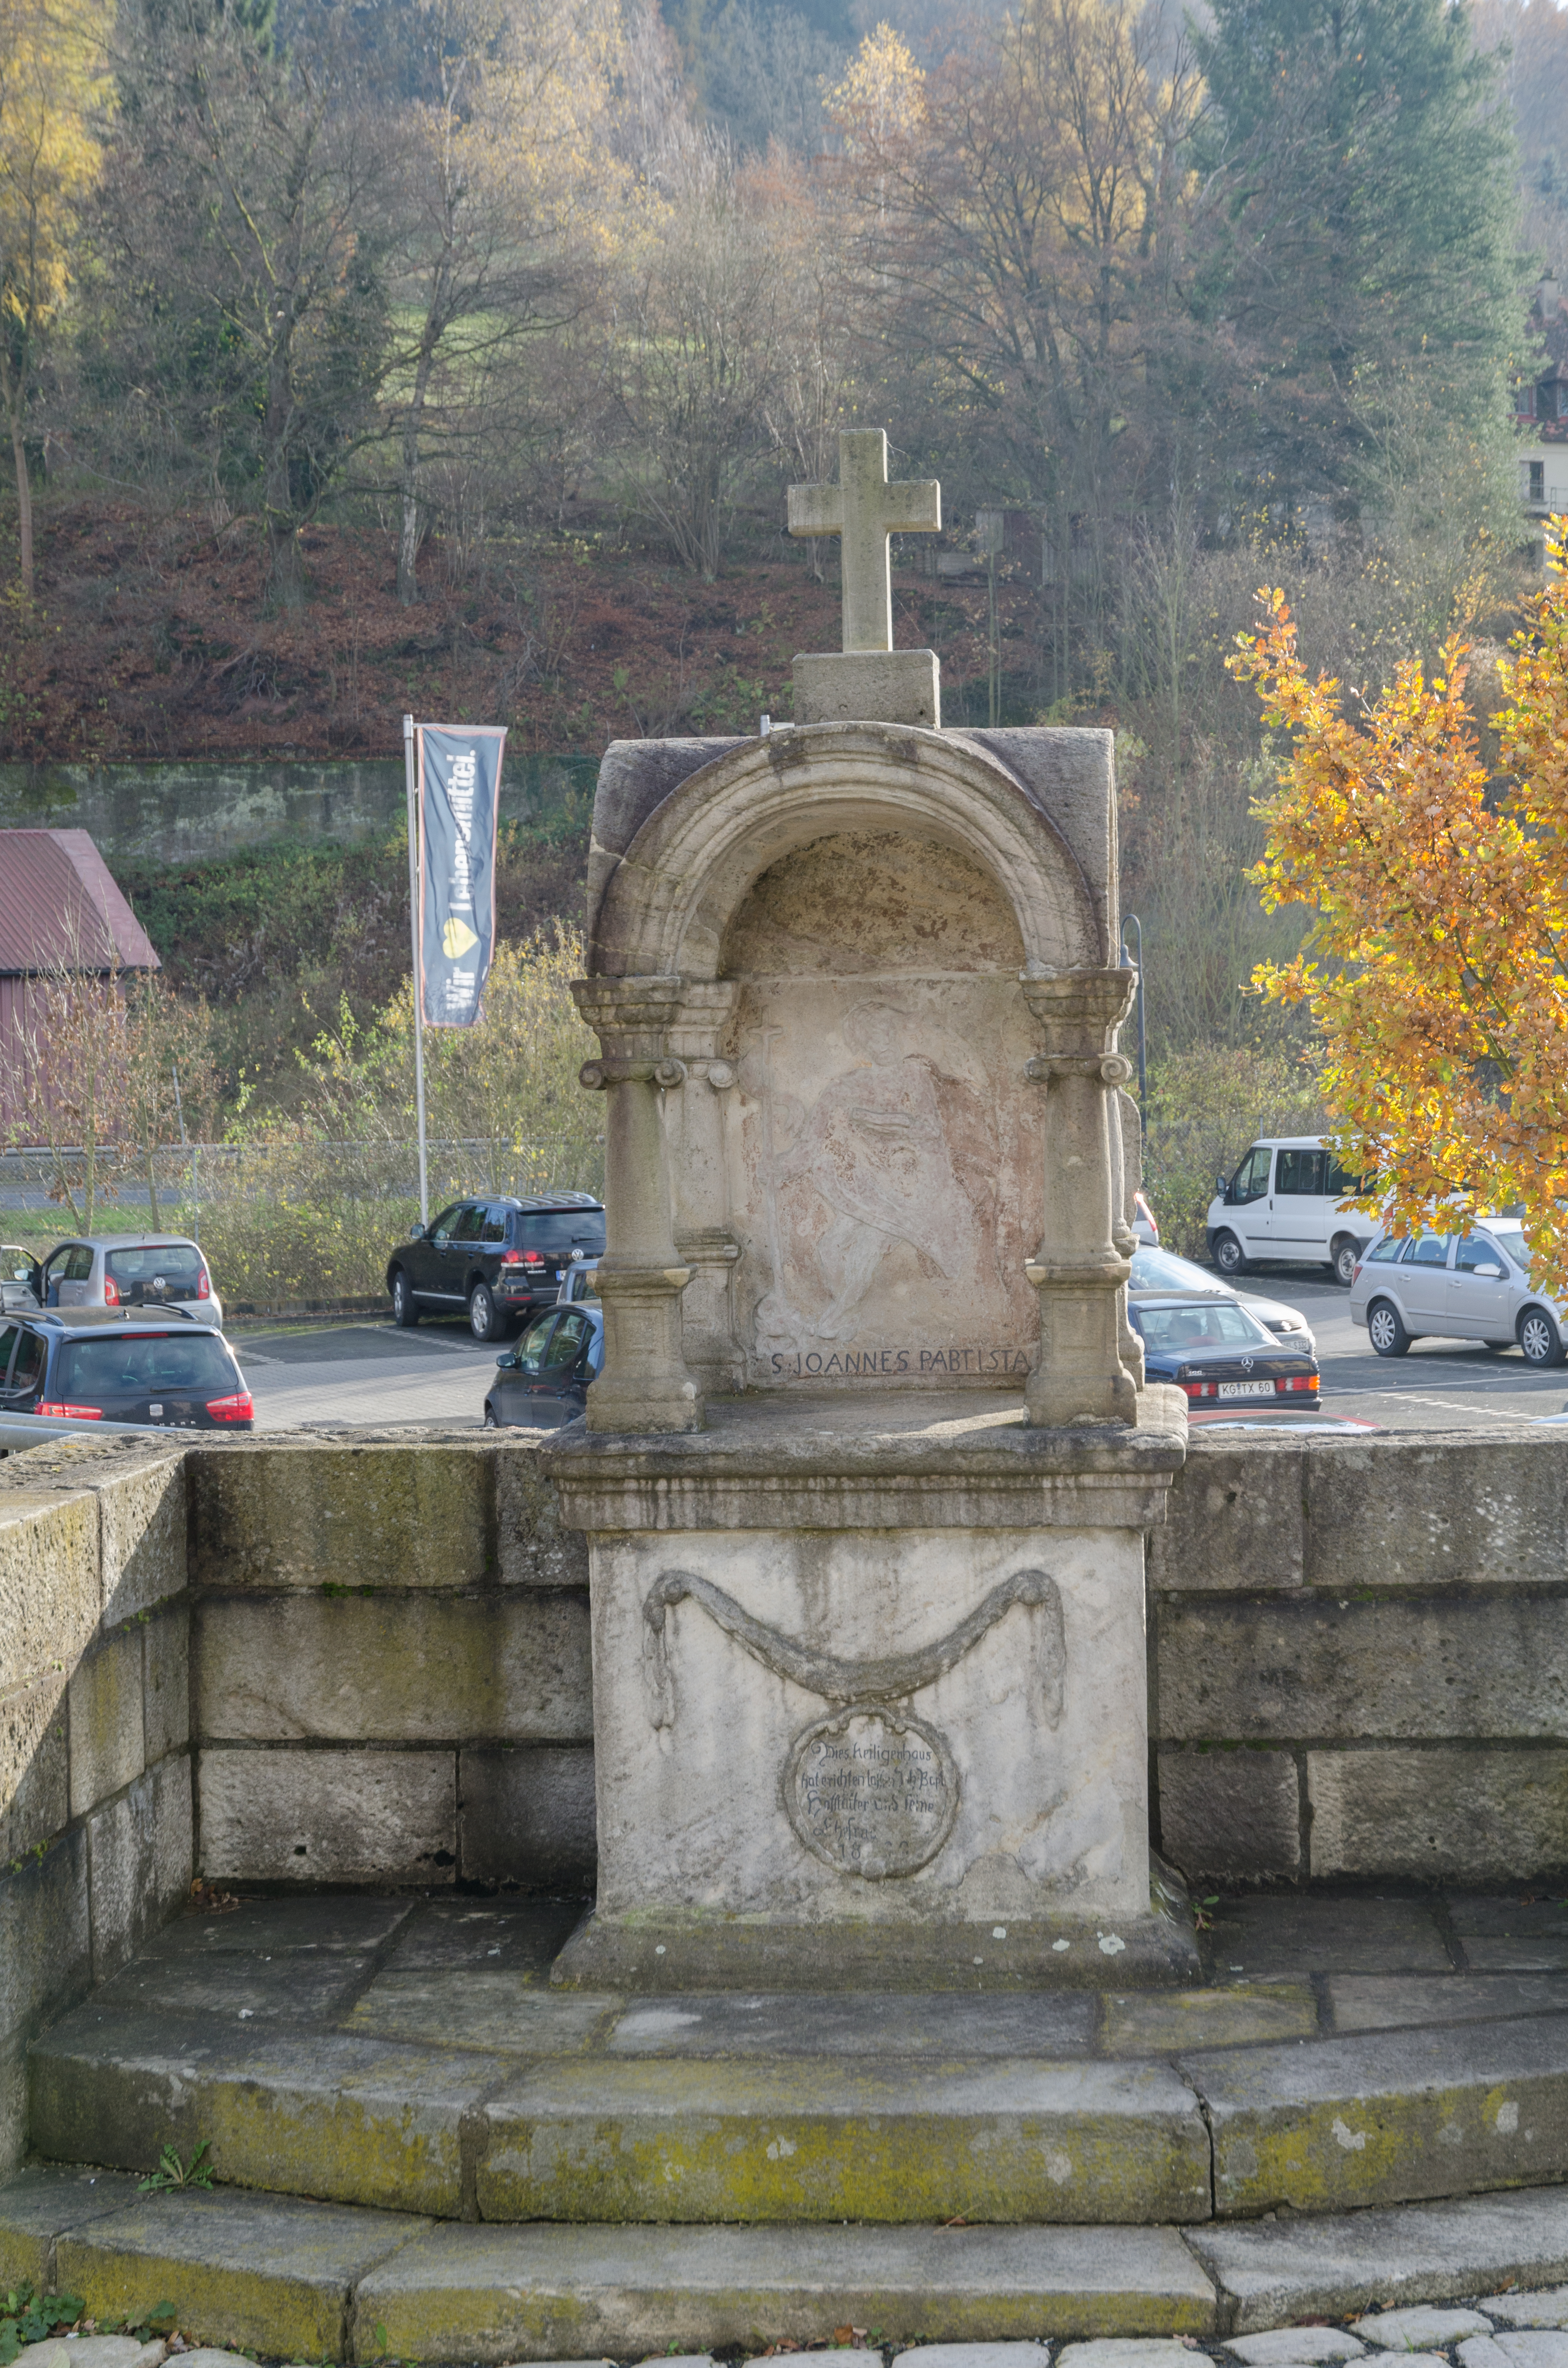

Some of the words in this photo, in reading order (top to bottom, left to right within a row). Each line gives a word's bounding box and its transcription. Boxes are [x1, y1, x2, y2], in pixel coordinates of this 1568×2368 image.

[446, 967, 475, 1010] Wir
[793, 1350, 910, 1375] JOANNES
[919, 1349, 1034, 1371] PABTISTA
[1259, 1382, 1270, 1393] 60
[811, 1740, 849, 1767] Dies
